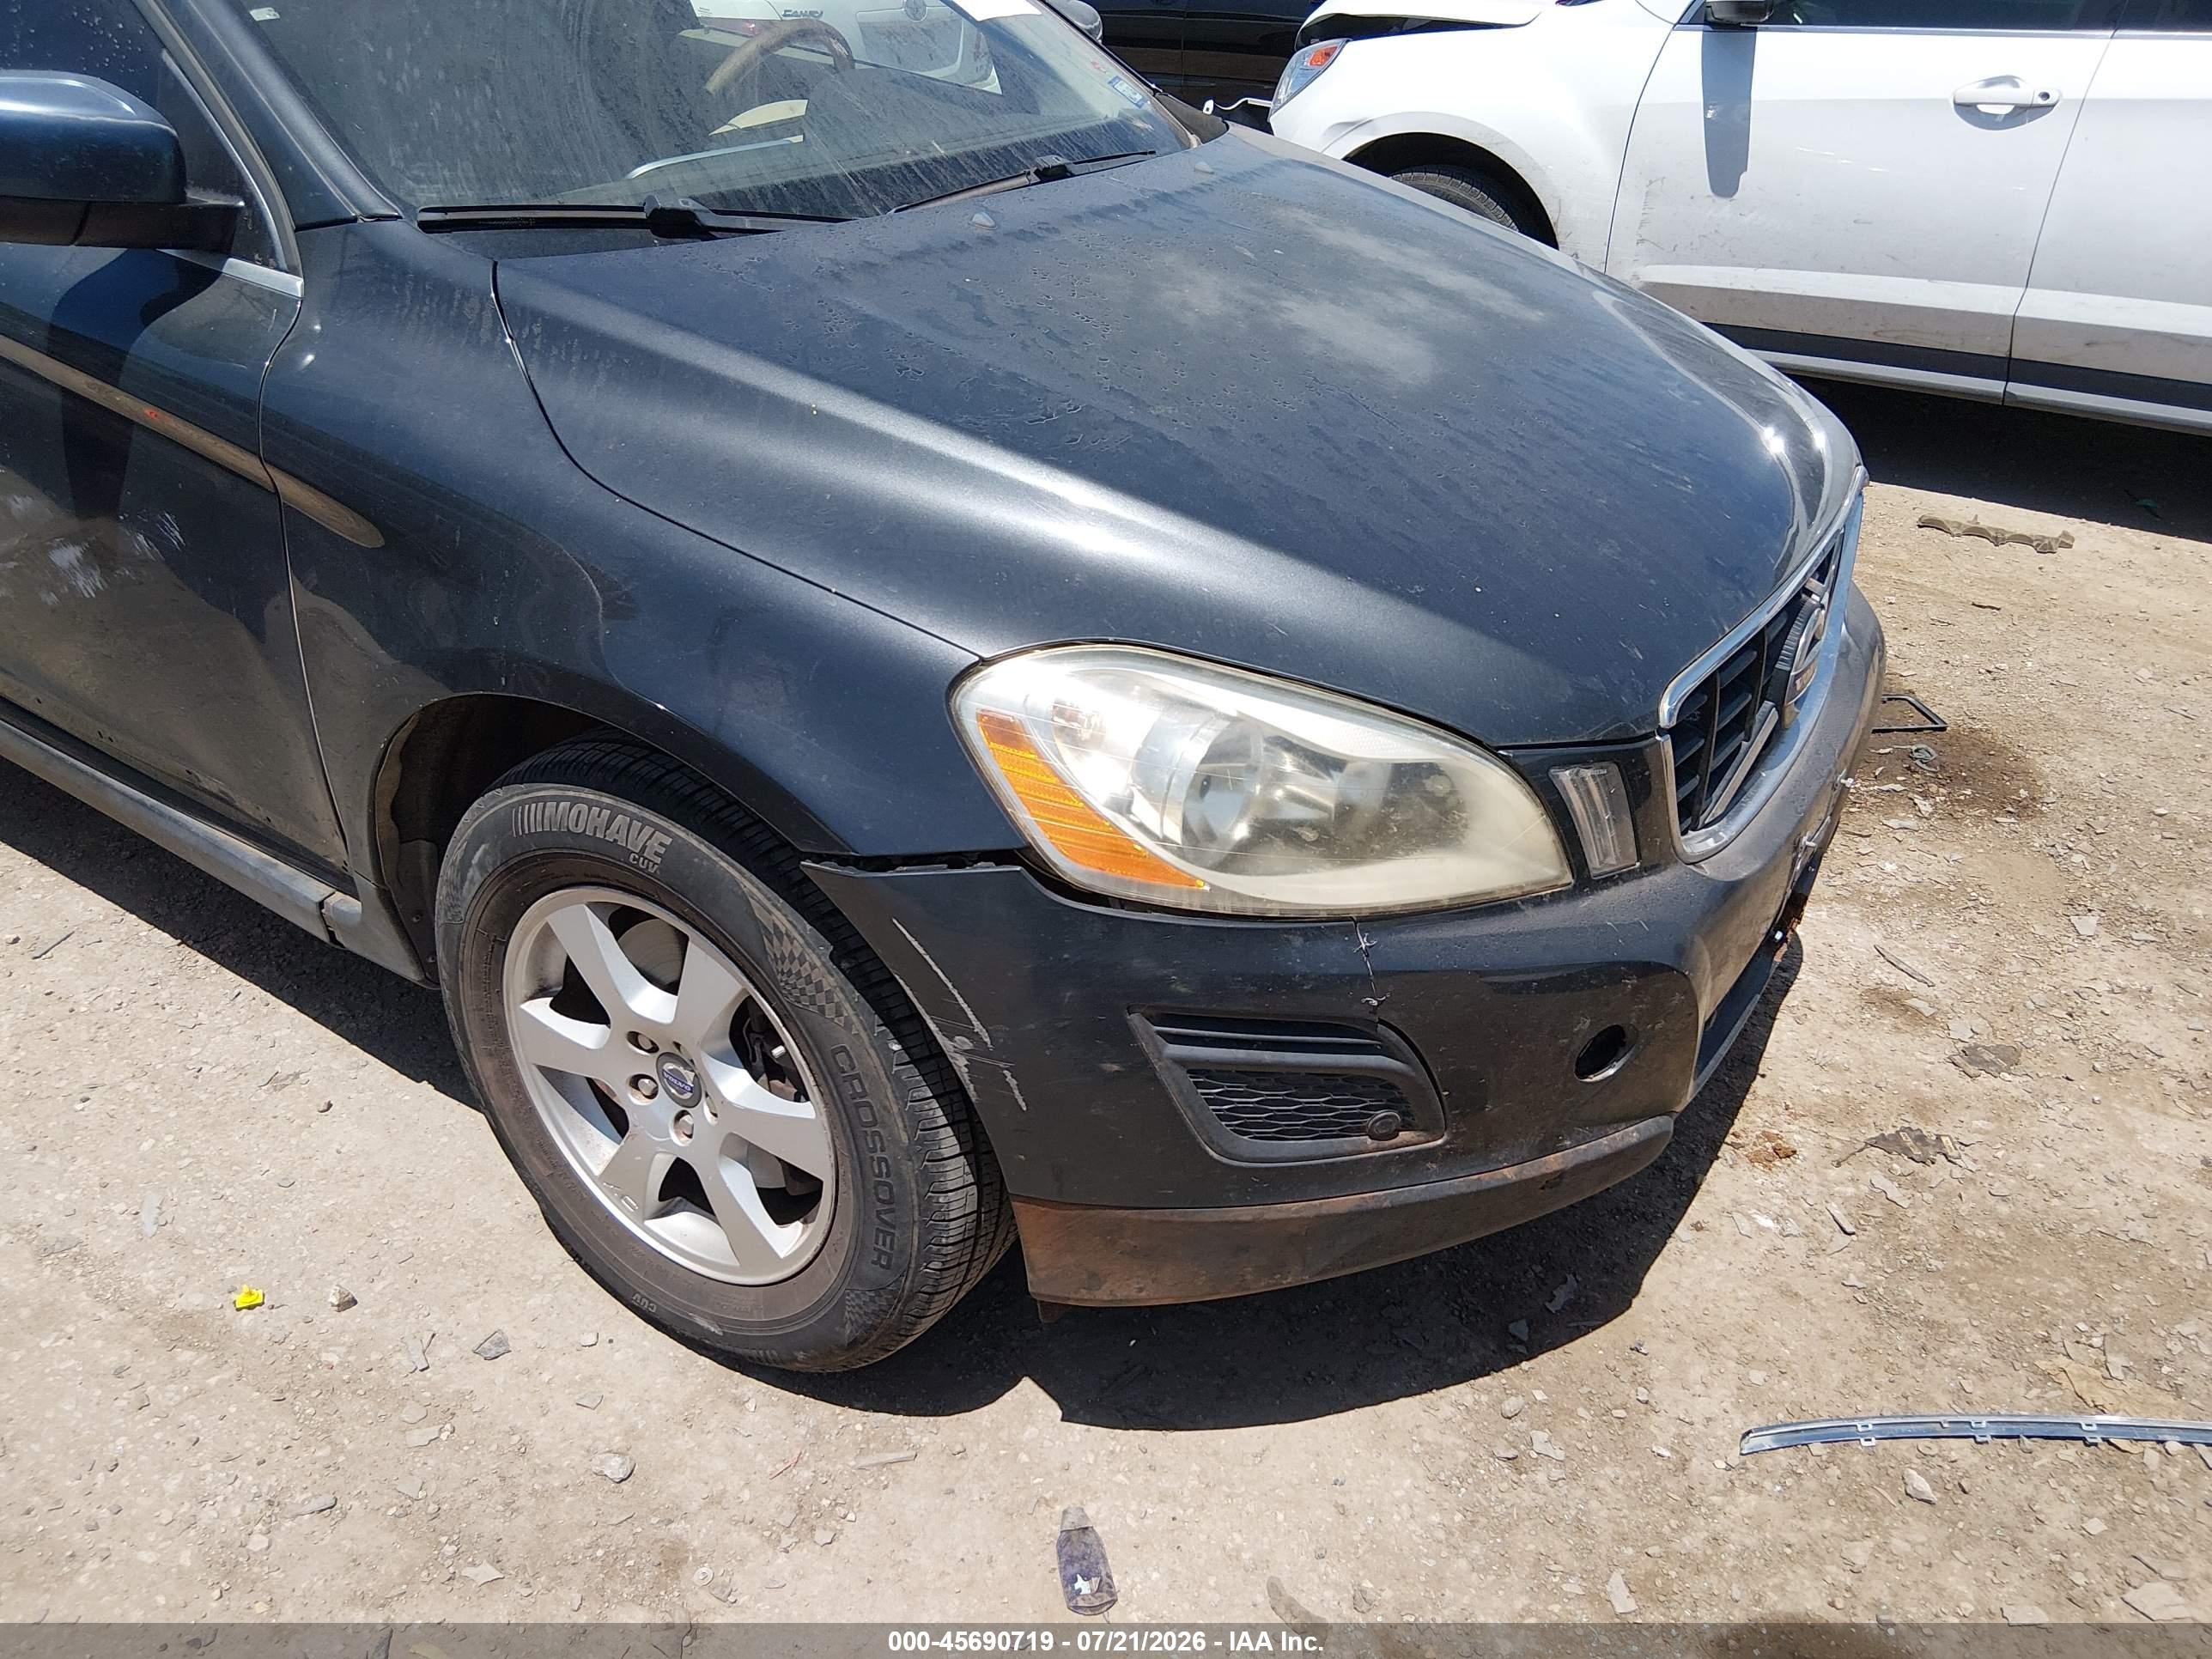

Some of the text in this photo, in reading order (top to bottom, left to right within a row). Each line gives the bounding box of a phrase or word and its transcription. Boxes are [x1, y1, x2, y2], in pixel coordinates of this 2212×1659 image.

[543, 801, 673, 865] MOHAVE
[629, 853, 659, 874] CUV
[663, 1071, 692, 1091] VOLVO
[830, 1043, 896, 1271] CROSSOVER
